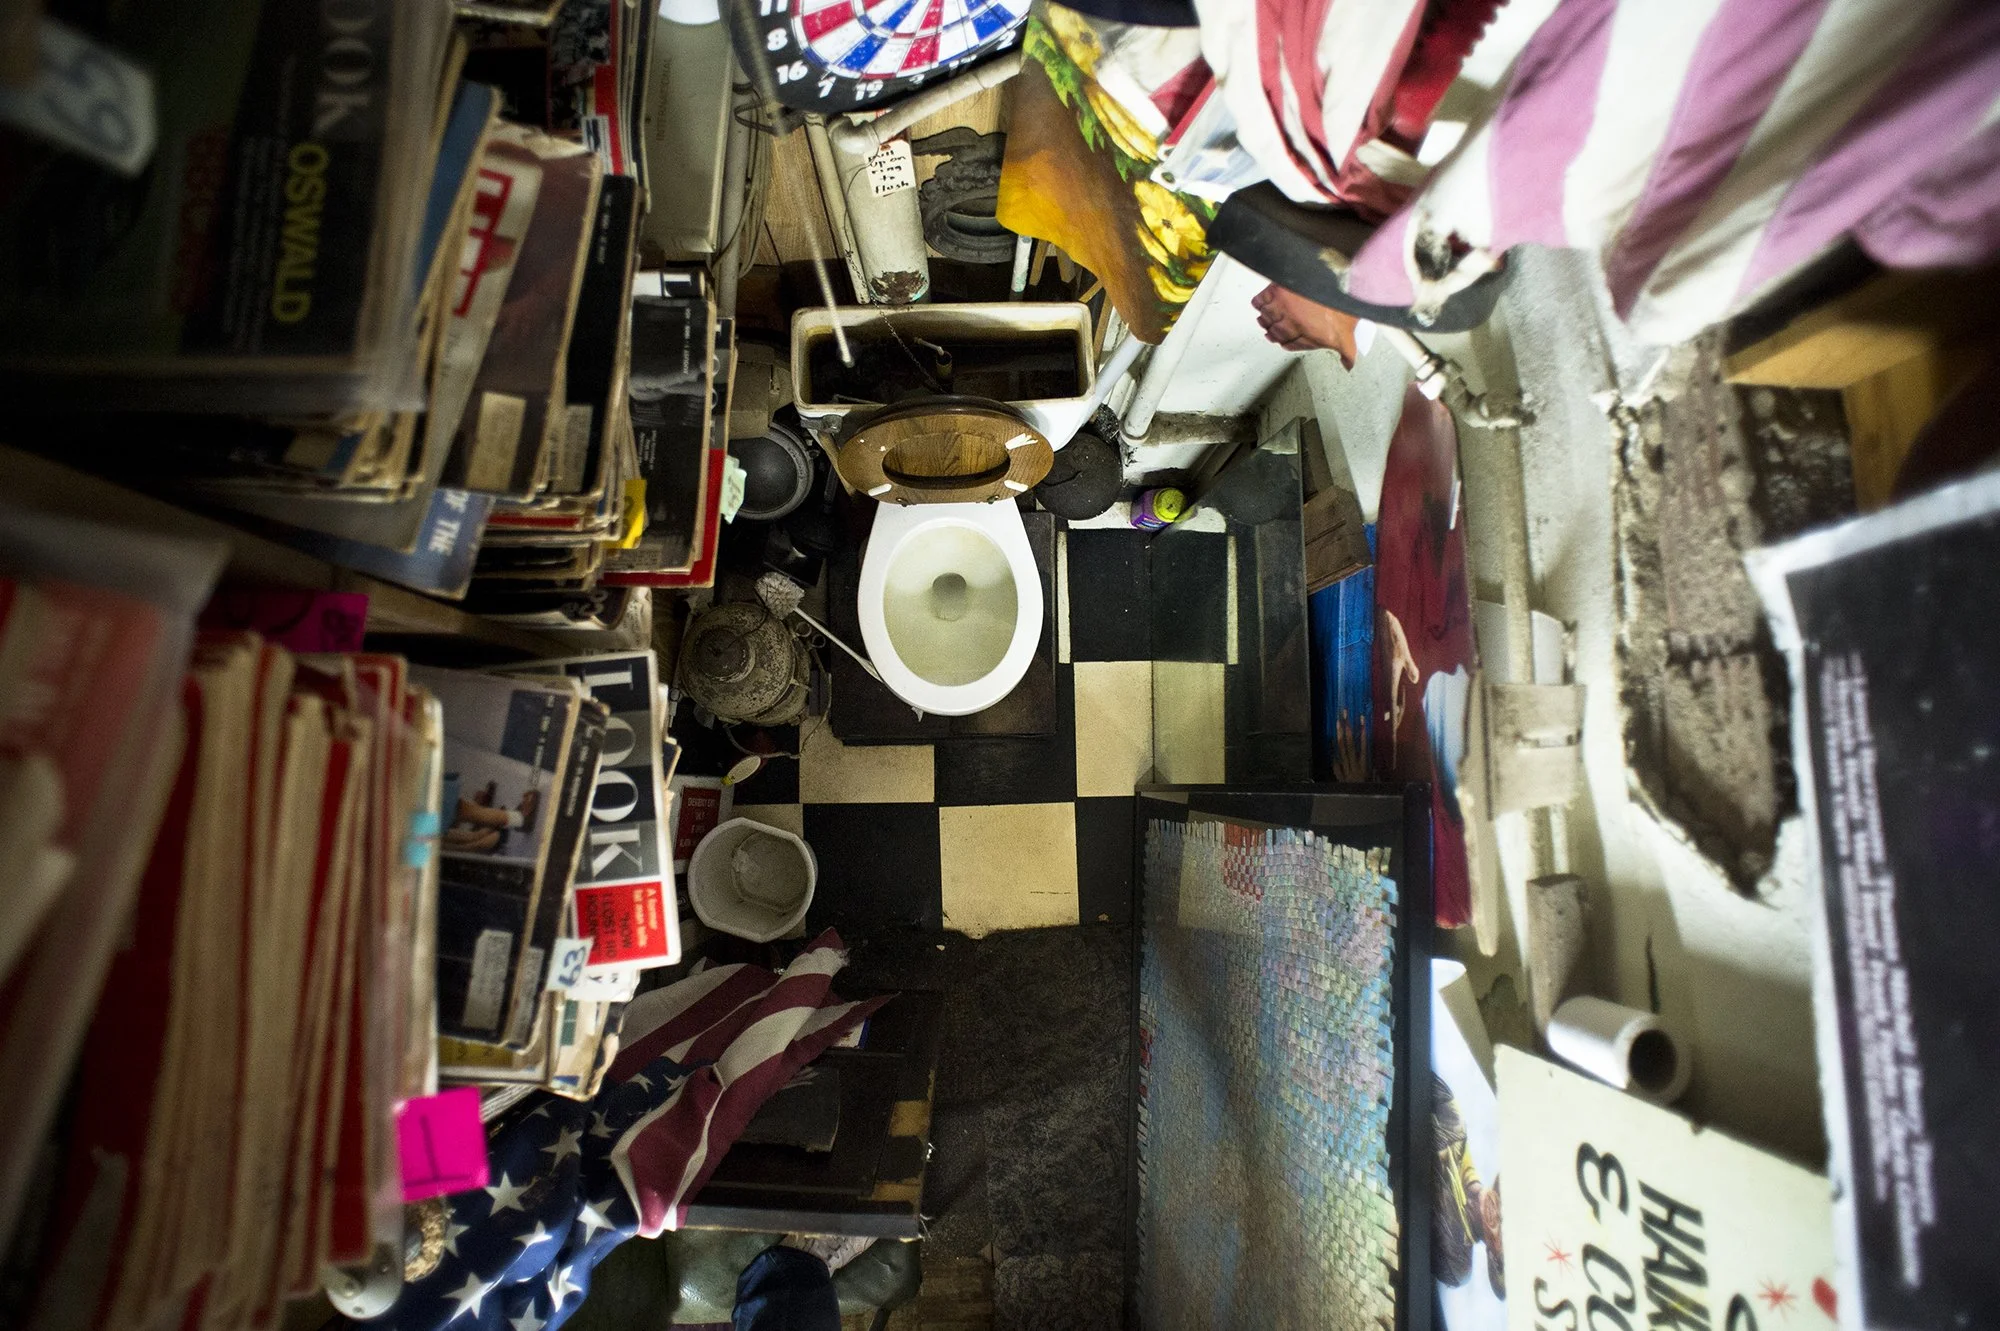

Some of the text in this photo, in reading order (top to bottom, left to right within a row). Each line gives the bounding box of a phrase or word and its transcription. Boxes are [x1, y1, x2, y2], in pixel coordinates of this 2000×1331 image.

[767, 28, 788, 51] 8
[996, 30, 1016, 51] 2
[776, 60, 808, 85] 16
[818, 77, 836, 98] 7
[855, 79, 884, 101] 19
[271, 142, 331, 324] OSWALD
[583, 664, 644, 876] LOOK
[647, 888, 657, 897] A
[1533, 1277, 1578, 1331] S
